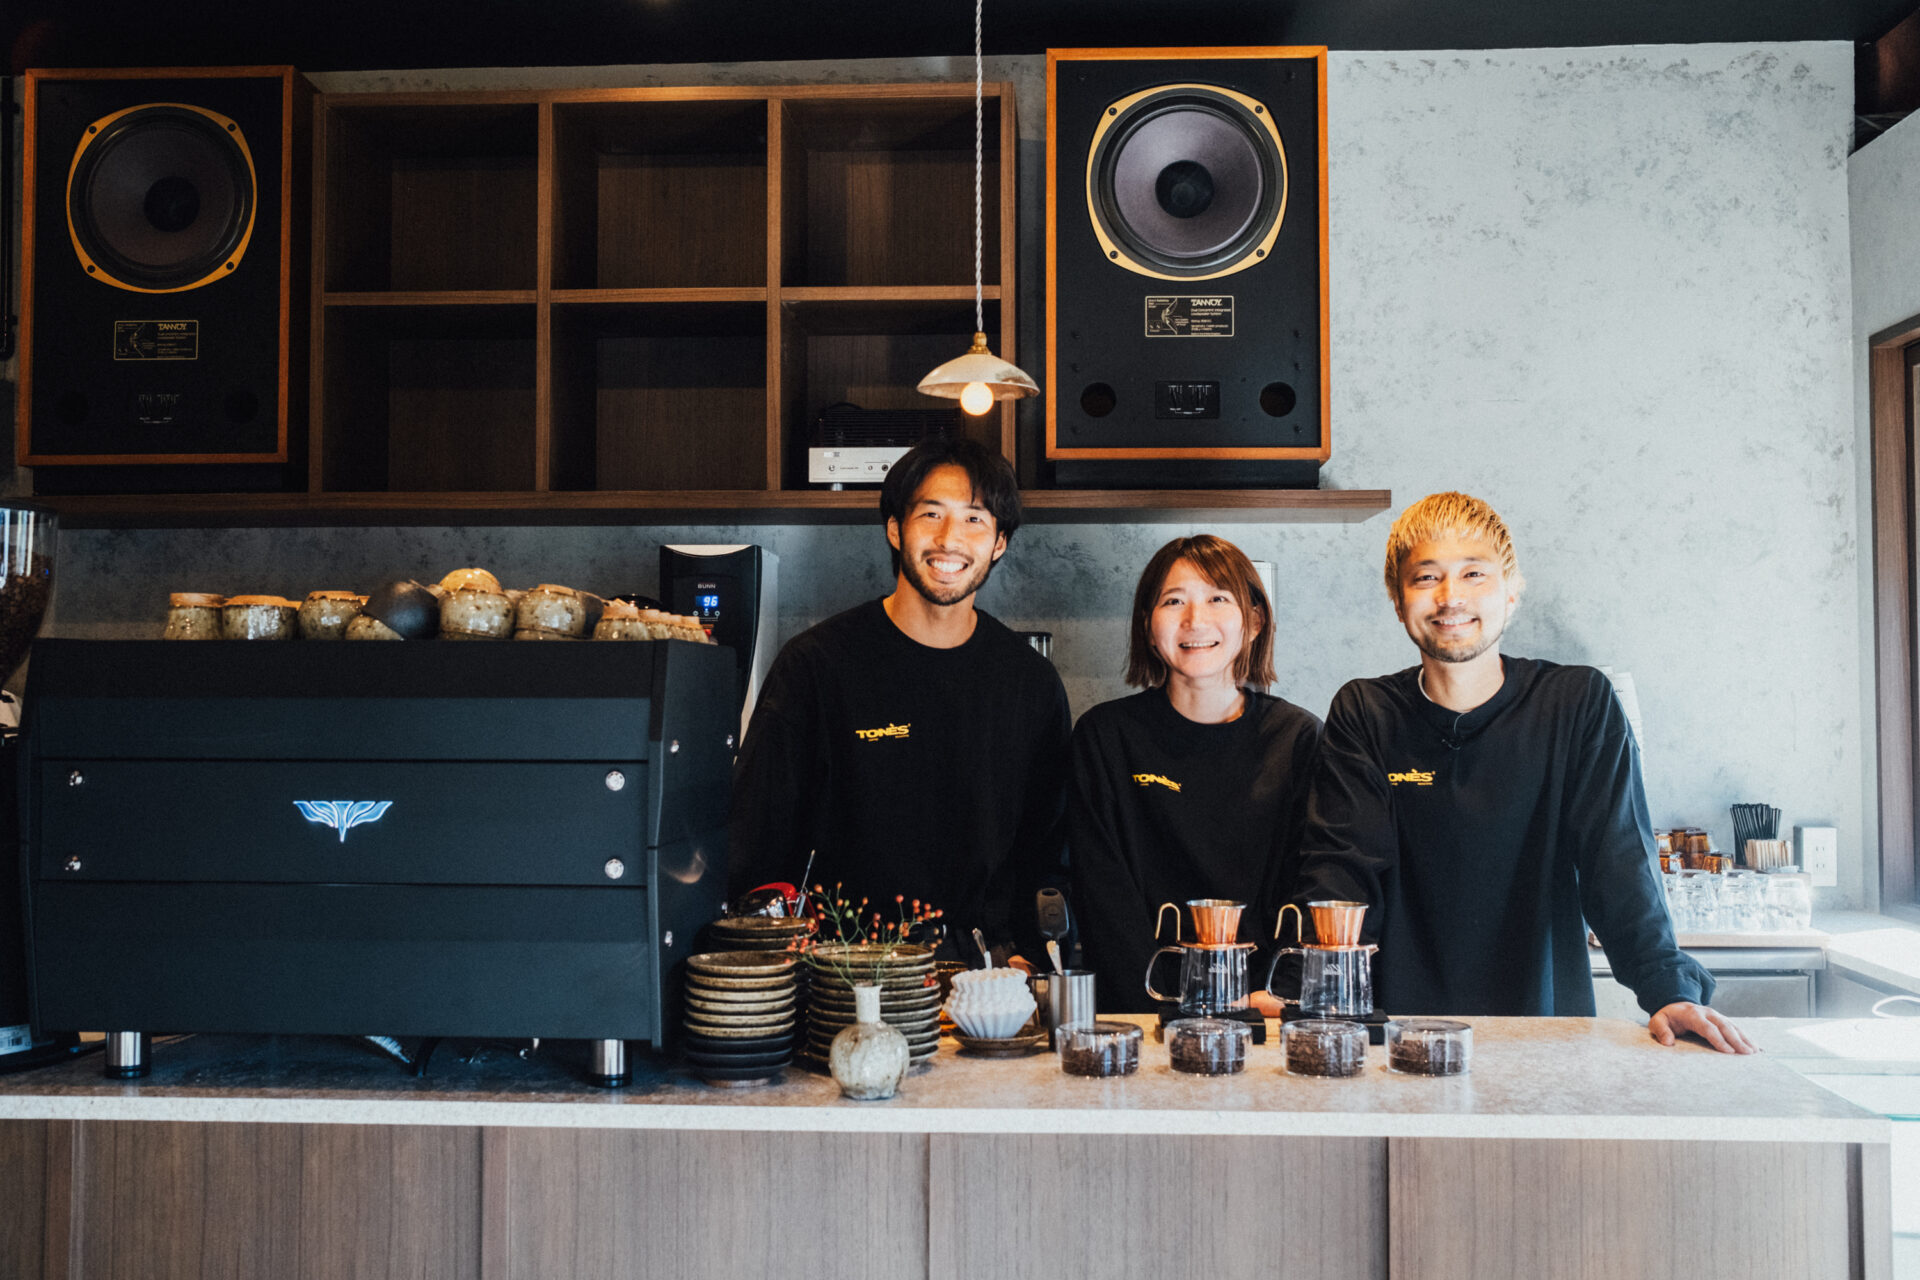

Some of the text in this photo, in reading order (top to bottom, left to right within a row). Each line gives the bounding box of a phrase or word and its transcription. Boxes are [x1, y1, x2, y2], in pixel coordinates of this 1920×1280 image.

[158, 323, 187, 331] TANNOY
[703, 596, 718, 607] 96
[1388, 768, 1434, 782] ONÈS
